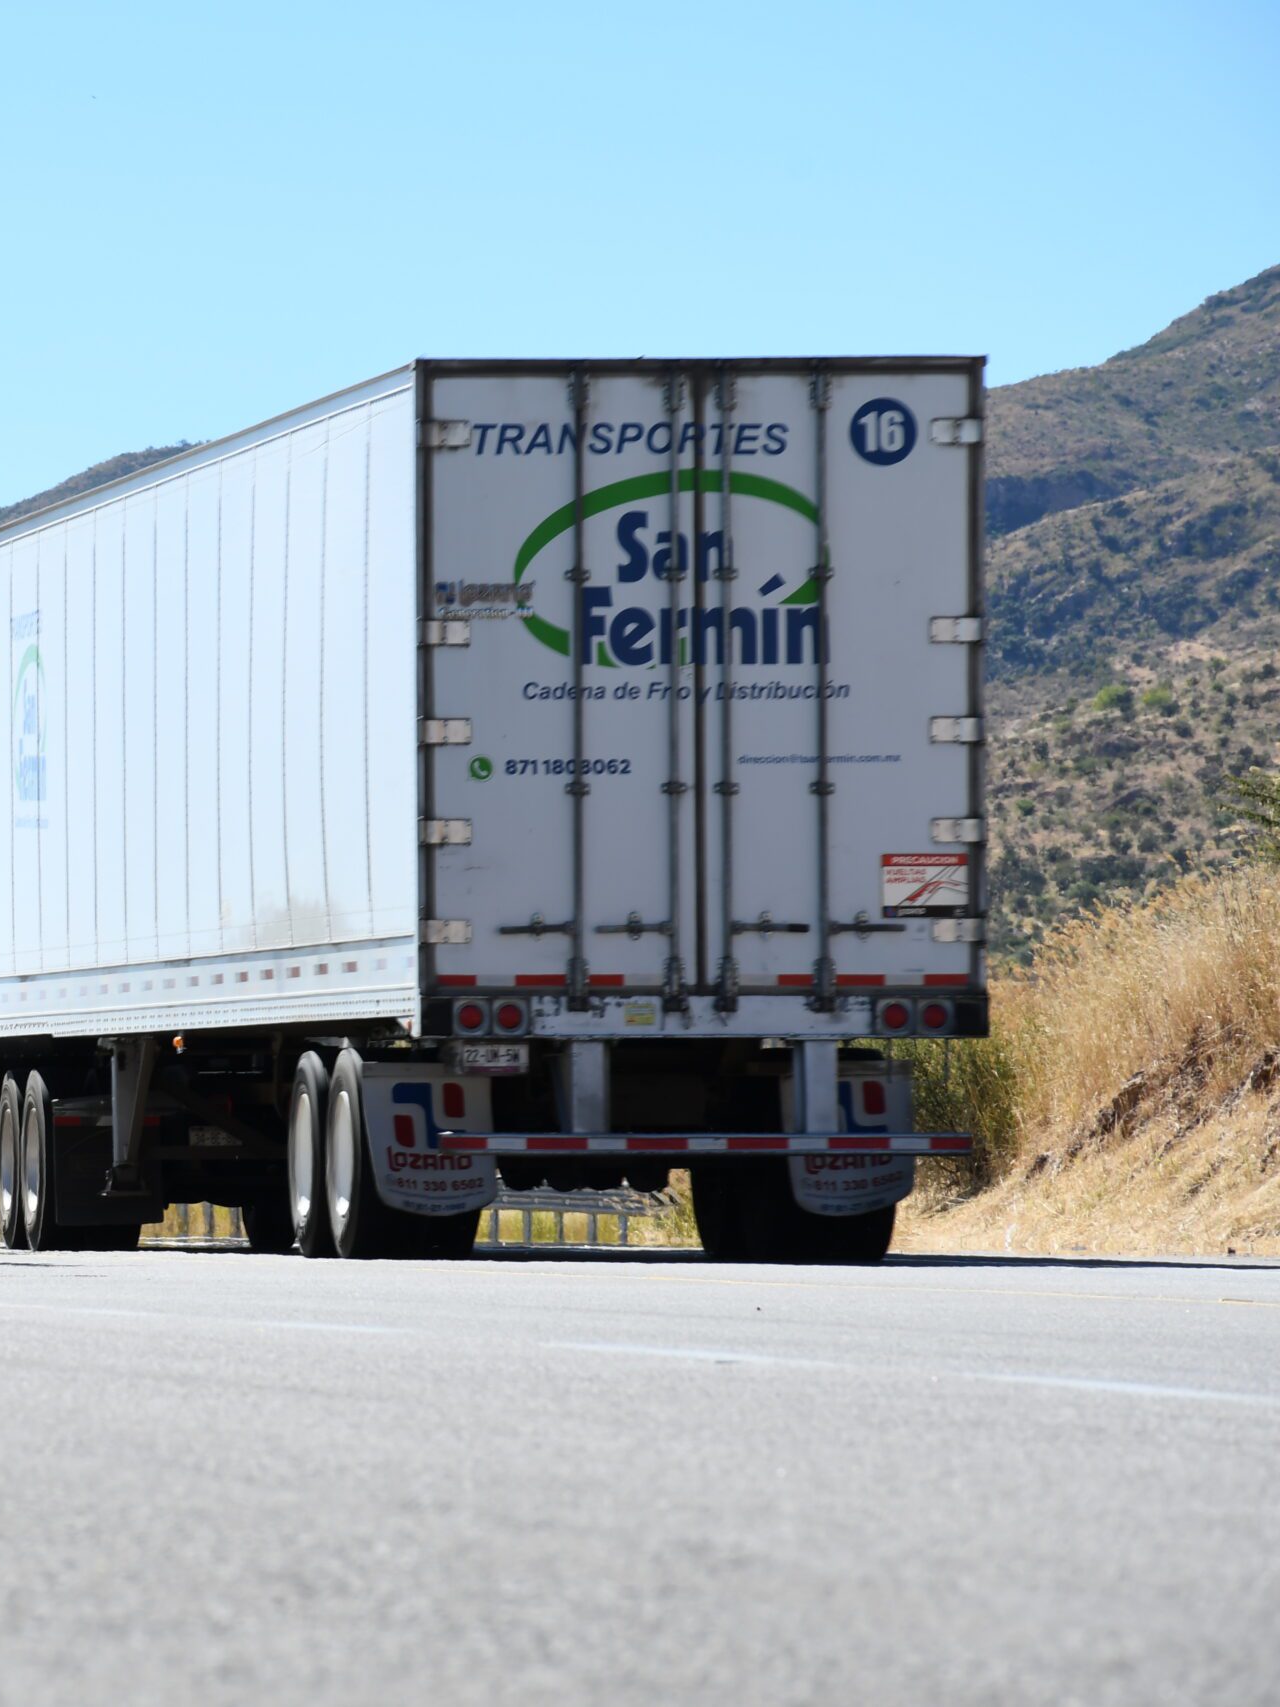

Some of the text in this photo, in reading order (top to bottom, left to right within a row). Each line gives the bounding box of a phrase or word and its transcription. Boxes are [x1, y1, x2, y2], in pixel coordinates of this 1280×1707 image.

[472, 421, 790, 456] TRANSPORTES
[857, 409, 905, 452] 16
[616, 510, 734, 584] San
[523, 680, 606, 700] Cadena
[614, 681, 642, 700] de
